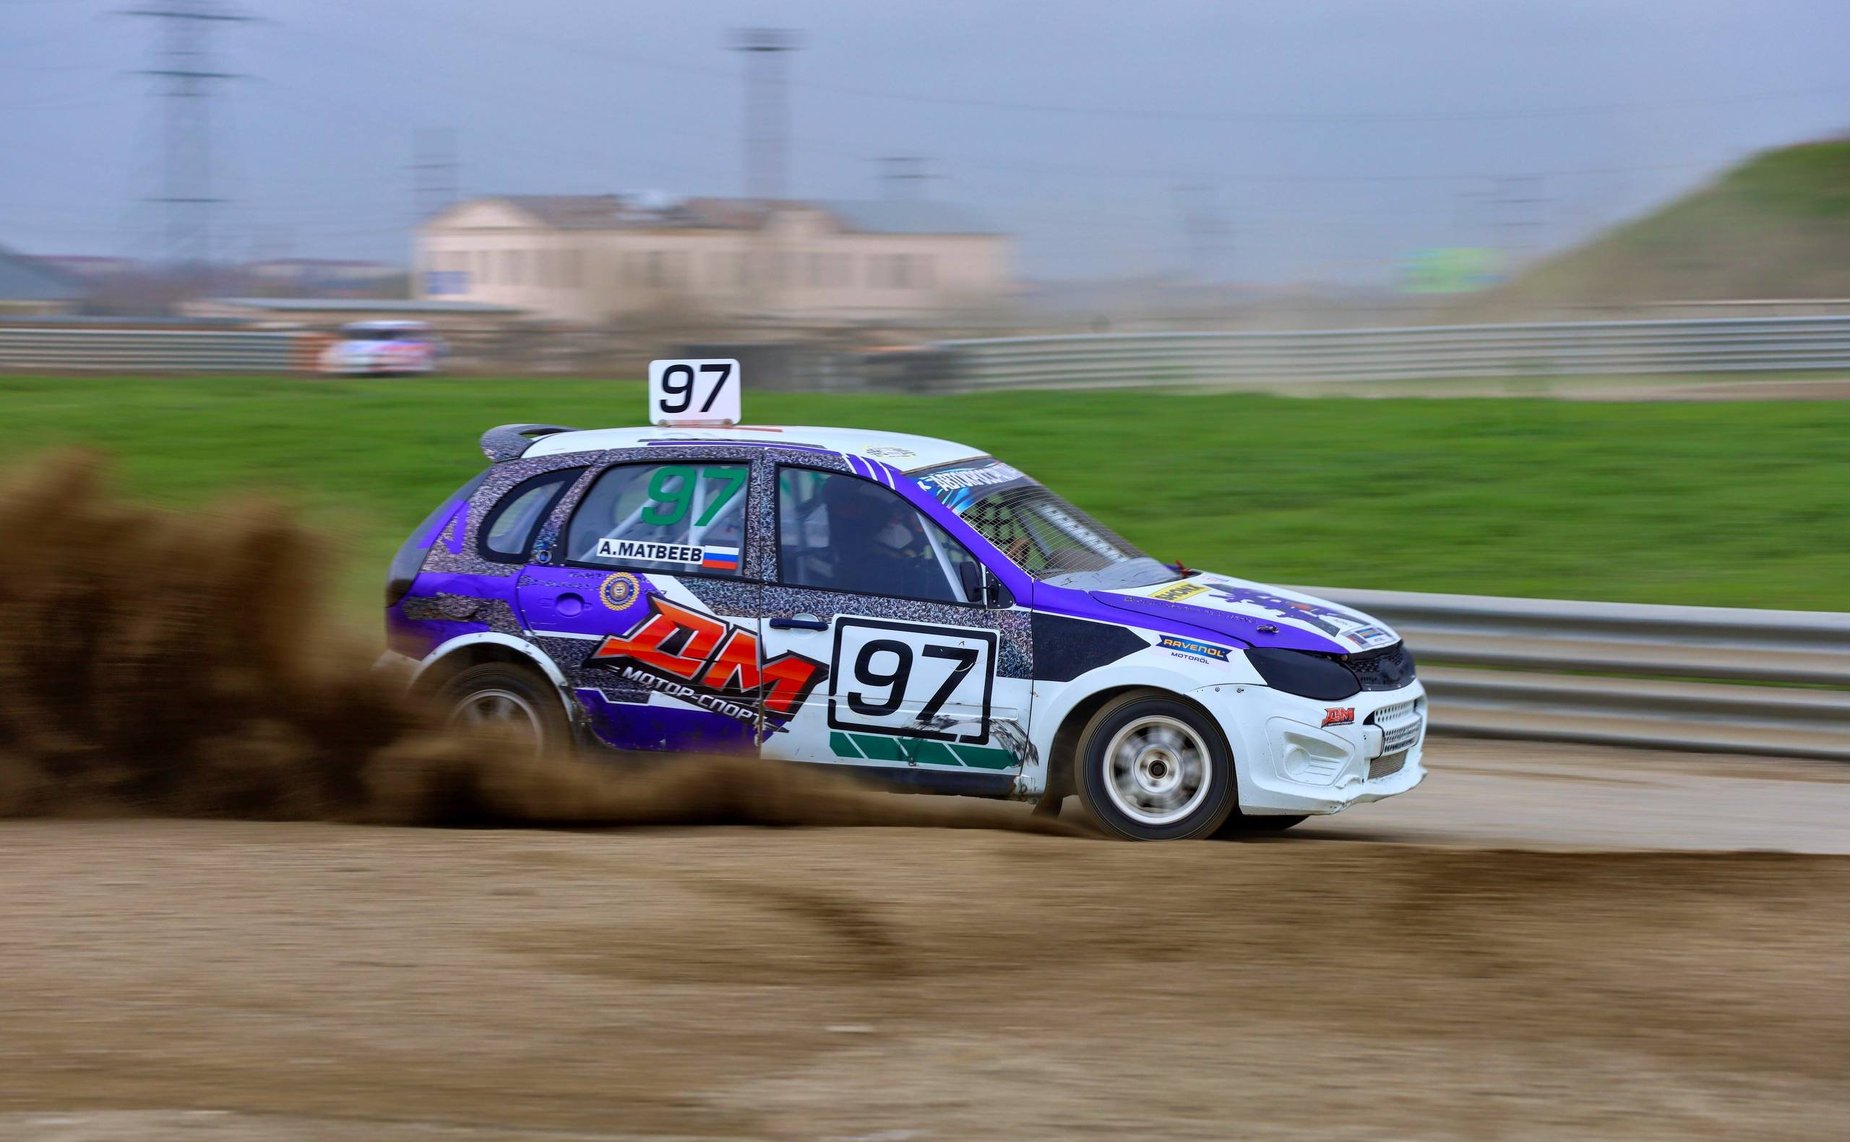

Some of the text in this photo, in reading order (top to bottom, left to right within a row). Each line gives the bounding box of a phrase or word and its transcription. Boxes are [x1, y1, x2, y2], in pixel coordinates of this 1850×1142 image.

[659, 363, 733, 414] 97
[640, 465, 749, 527] 97
[600, 541, 702, 562] А.МАТВЕЕВ
[1163, 638, 1225, 658] RAVENOL
[847, 639, 980, 721] 97
